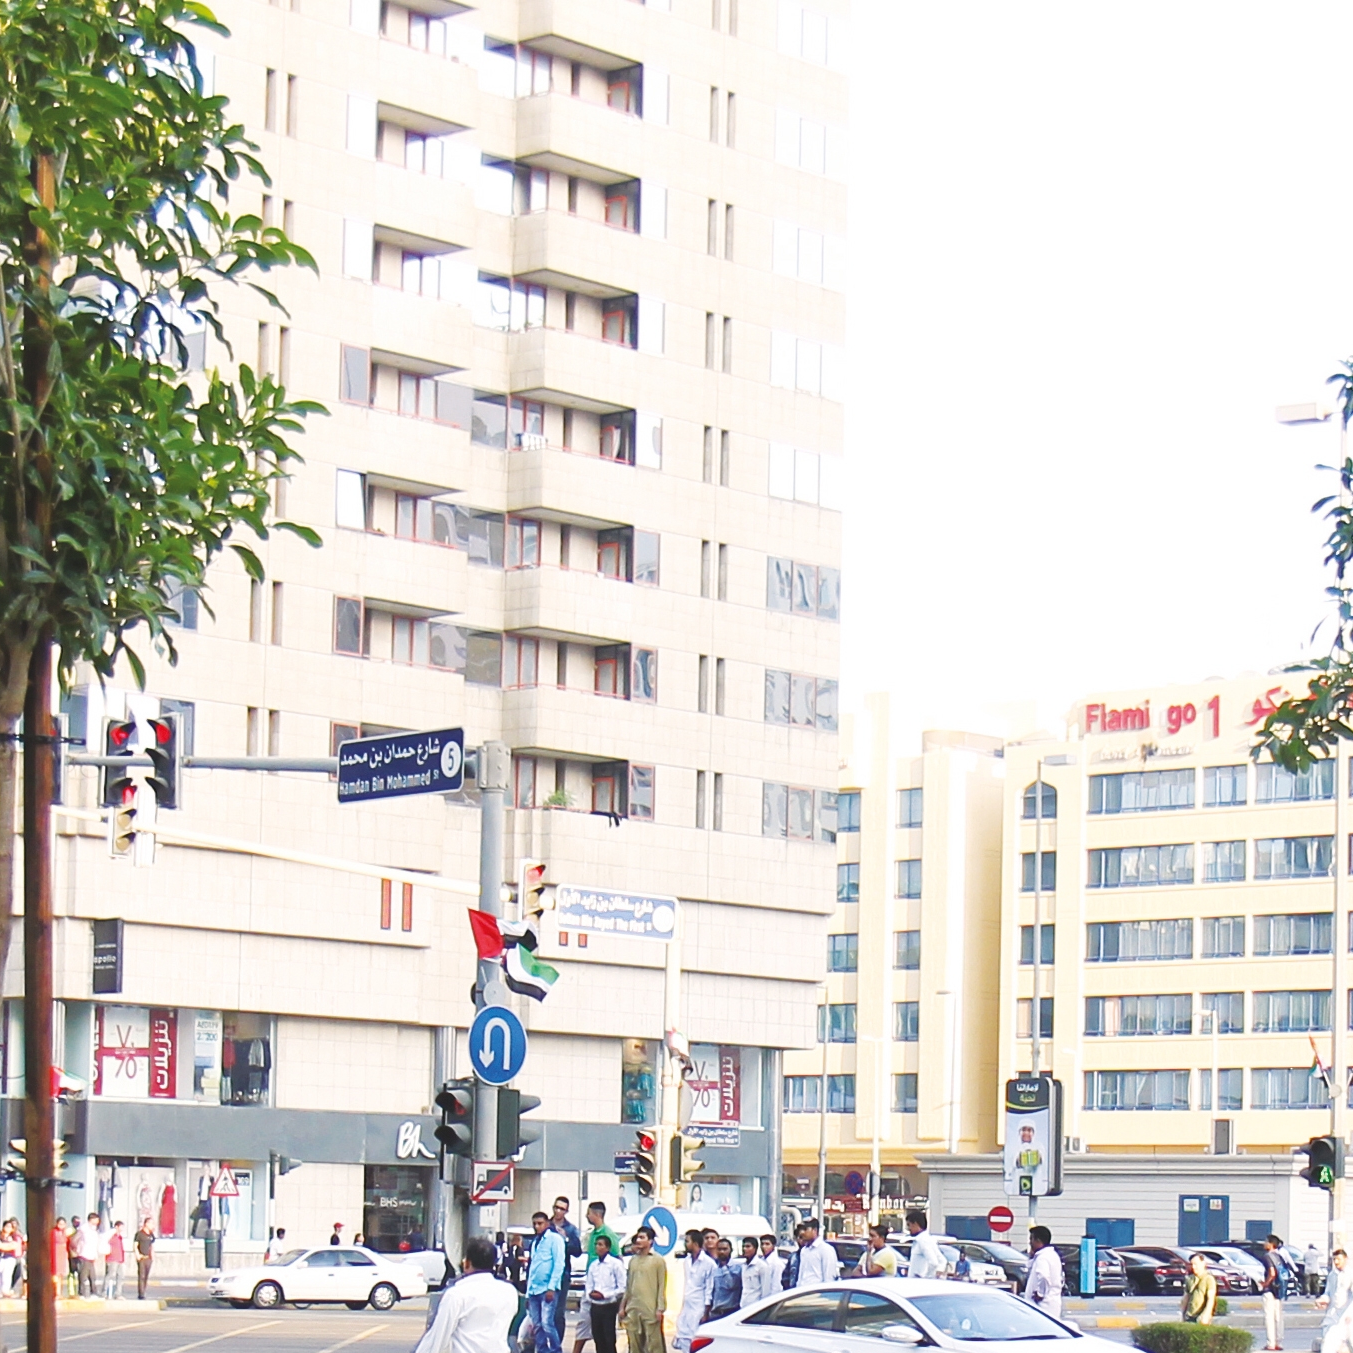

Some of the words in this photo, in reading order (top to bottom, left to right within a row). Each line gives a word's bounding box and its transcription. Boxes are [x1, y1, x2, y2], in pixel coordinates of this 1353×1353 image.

[340, 752, 368, 766] محمد
[369, 747, 382, 768] بن
[384, 743, 415, 764] حمدان
[416, 737, 440, 765] شارع
[447, 747, 455, 772] 5
[339, 778, 369, 795] Hamdan
[372, 775, 384, 792] Bin
[387, 769, 431, 790] Mohammed
[155, 1020, 172, 1089] تنزيلات
[115, 1057, 137, 1079] 70
[723, 1056, 736, 1117] تنزيلات
[380, 1197, 398, 1208] BHS
